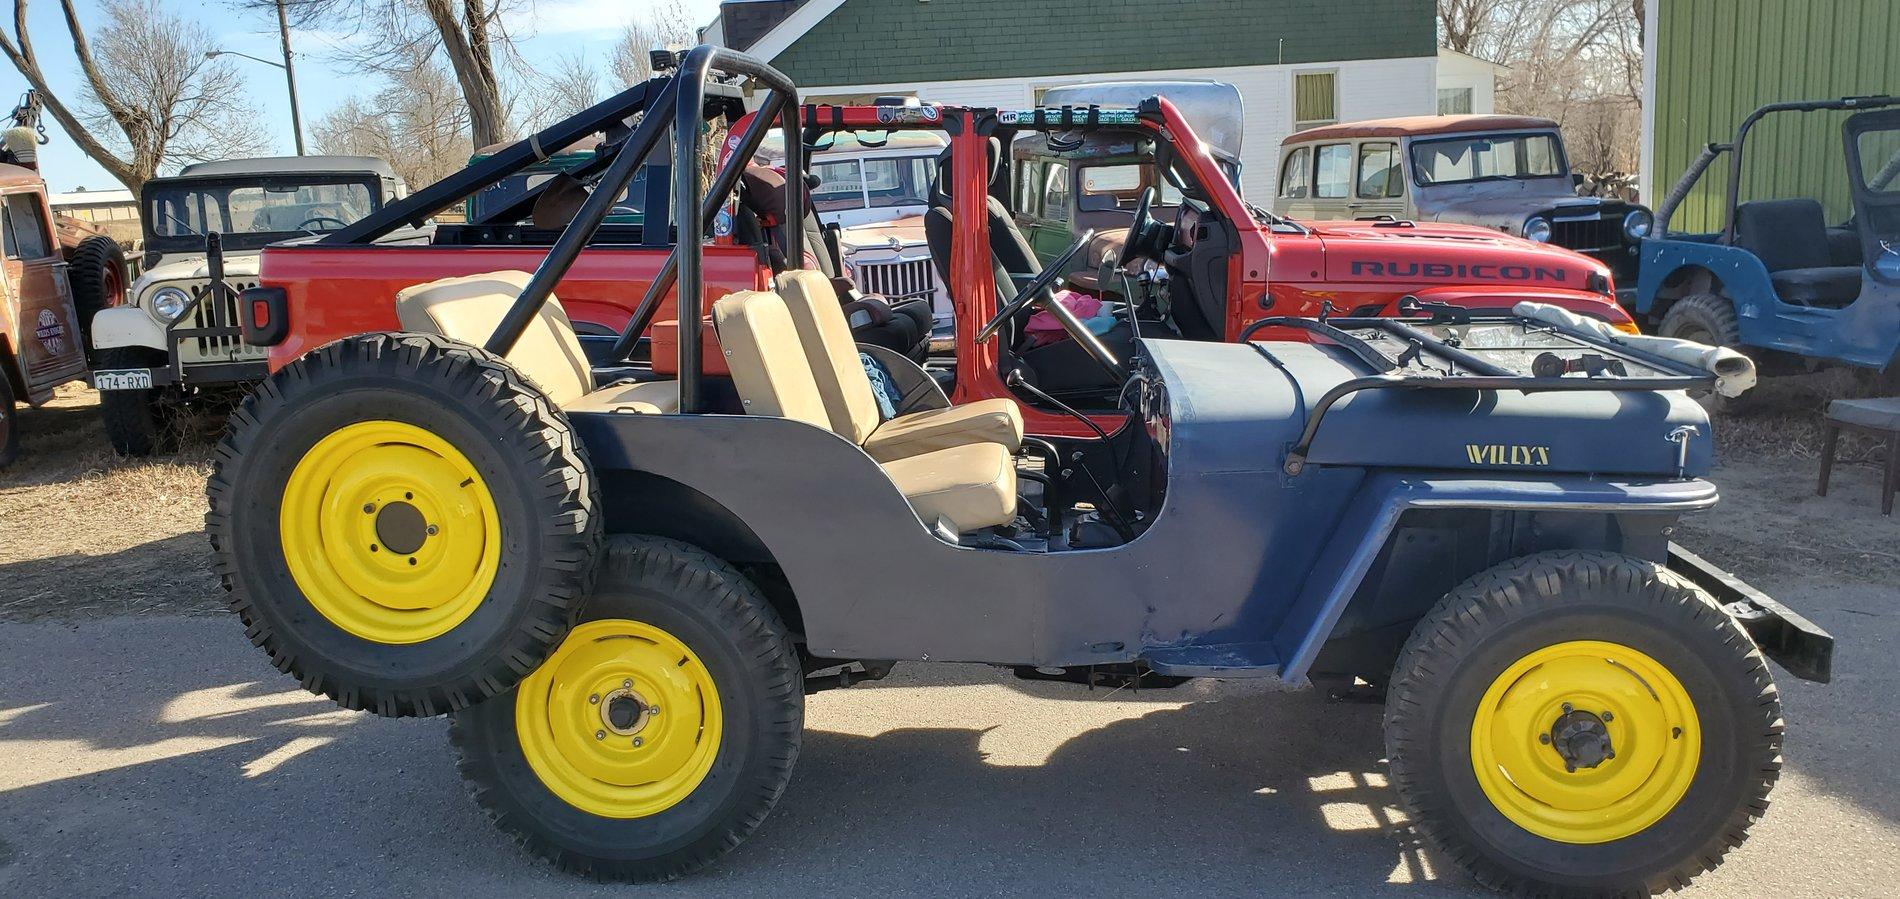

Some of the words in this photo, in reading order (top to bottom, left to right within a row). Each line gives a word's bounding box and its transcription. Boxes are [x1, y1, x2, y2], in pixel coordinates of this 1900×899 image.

[1002, 113, 1017, 122] HR
[1351, 261, 1566, 282] RUBICON
[1465, 444, 1549, 466] WILLYS
